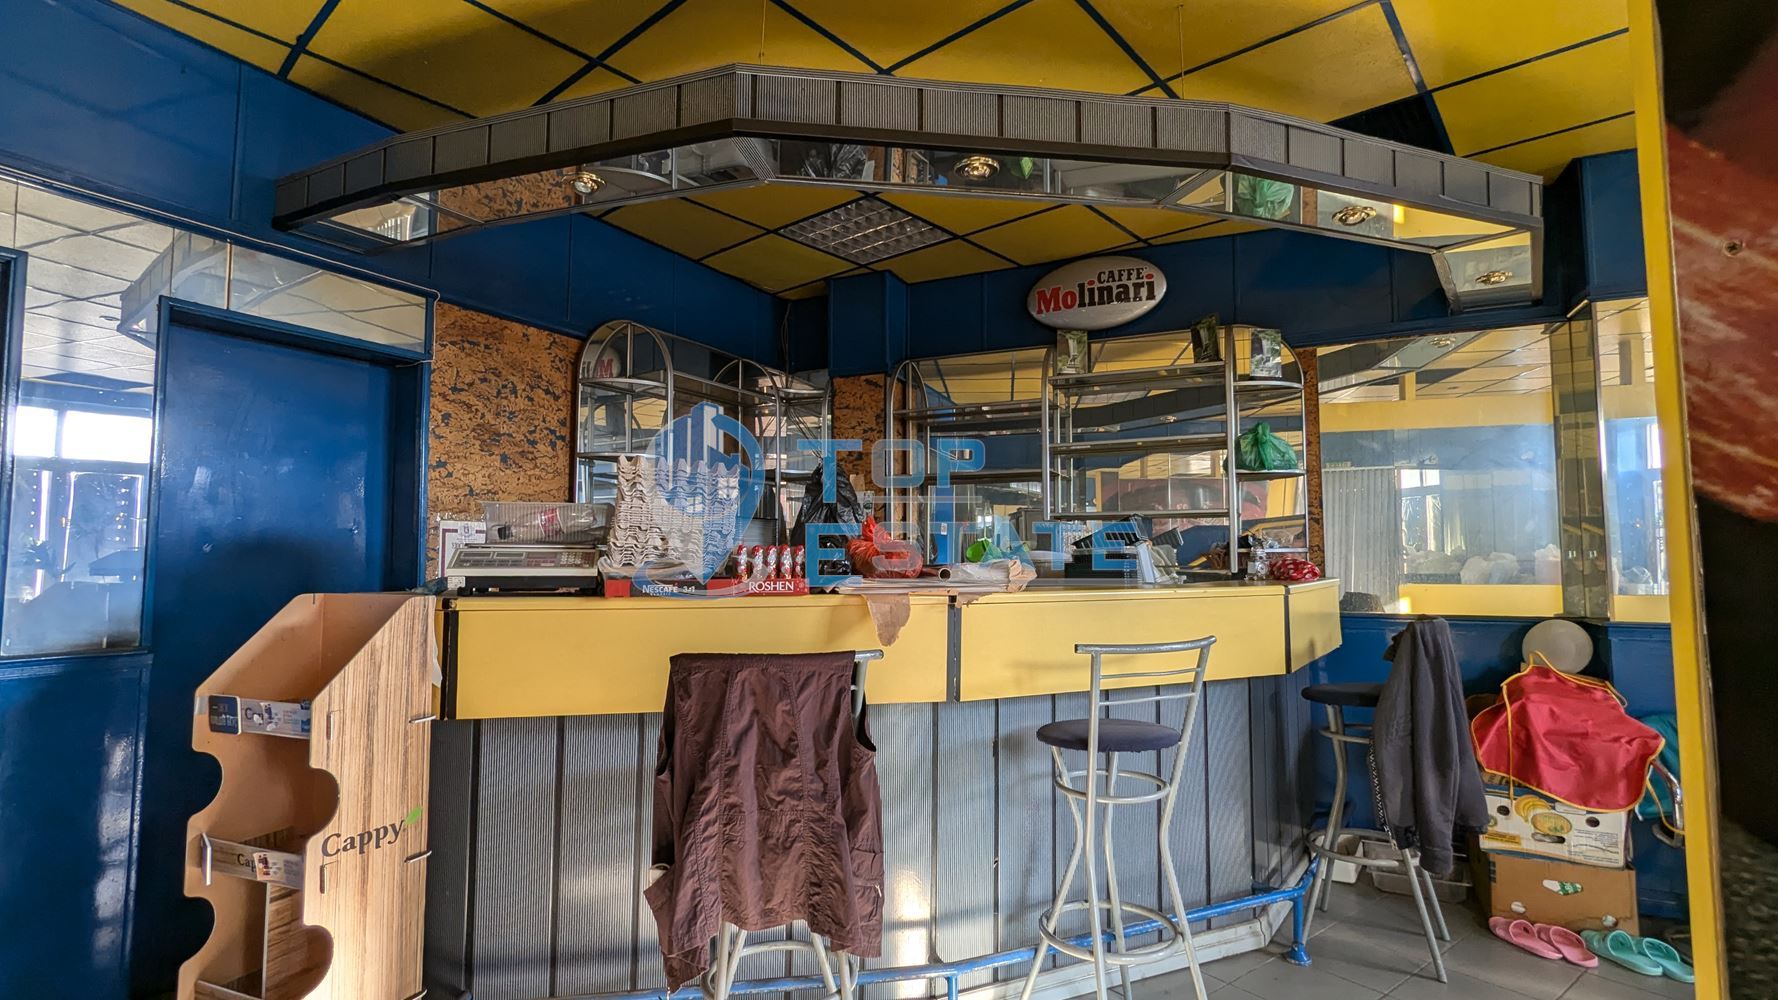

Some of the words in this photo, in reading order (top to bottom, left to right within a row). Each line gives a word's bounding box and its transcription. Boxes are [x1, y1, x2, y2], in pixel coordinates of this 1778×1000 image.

[1036, 273, 1156, 315] Molinari
[748, 581, 794, 592] ROSHEN
[321, 819, 405, 857] Cappy
